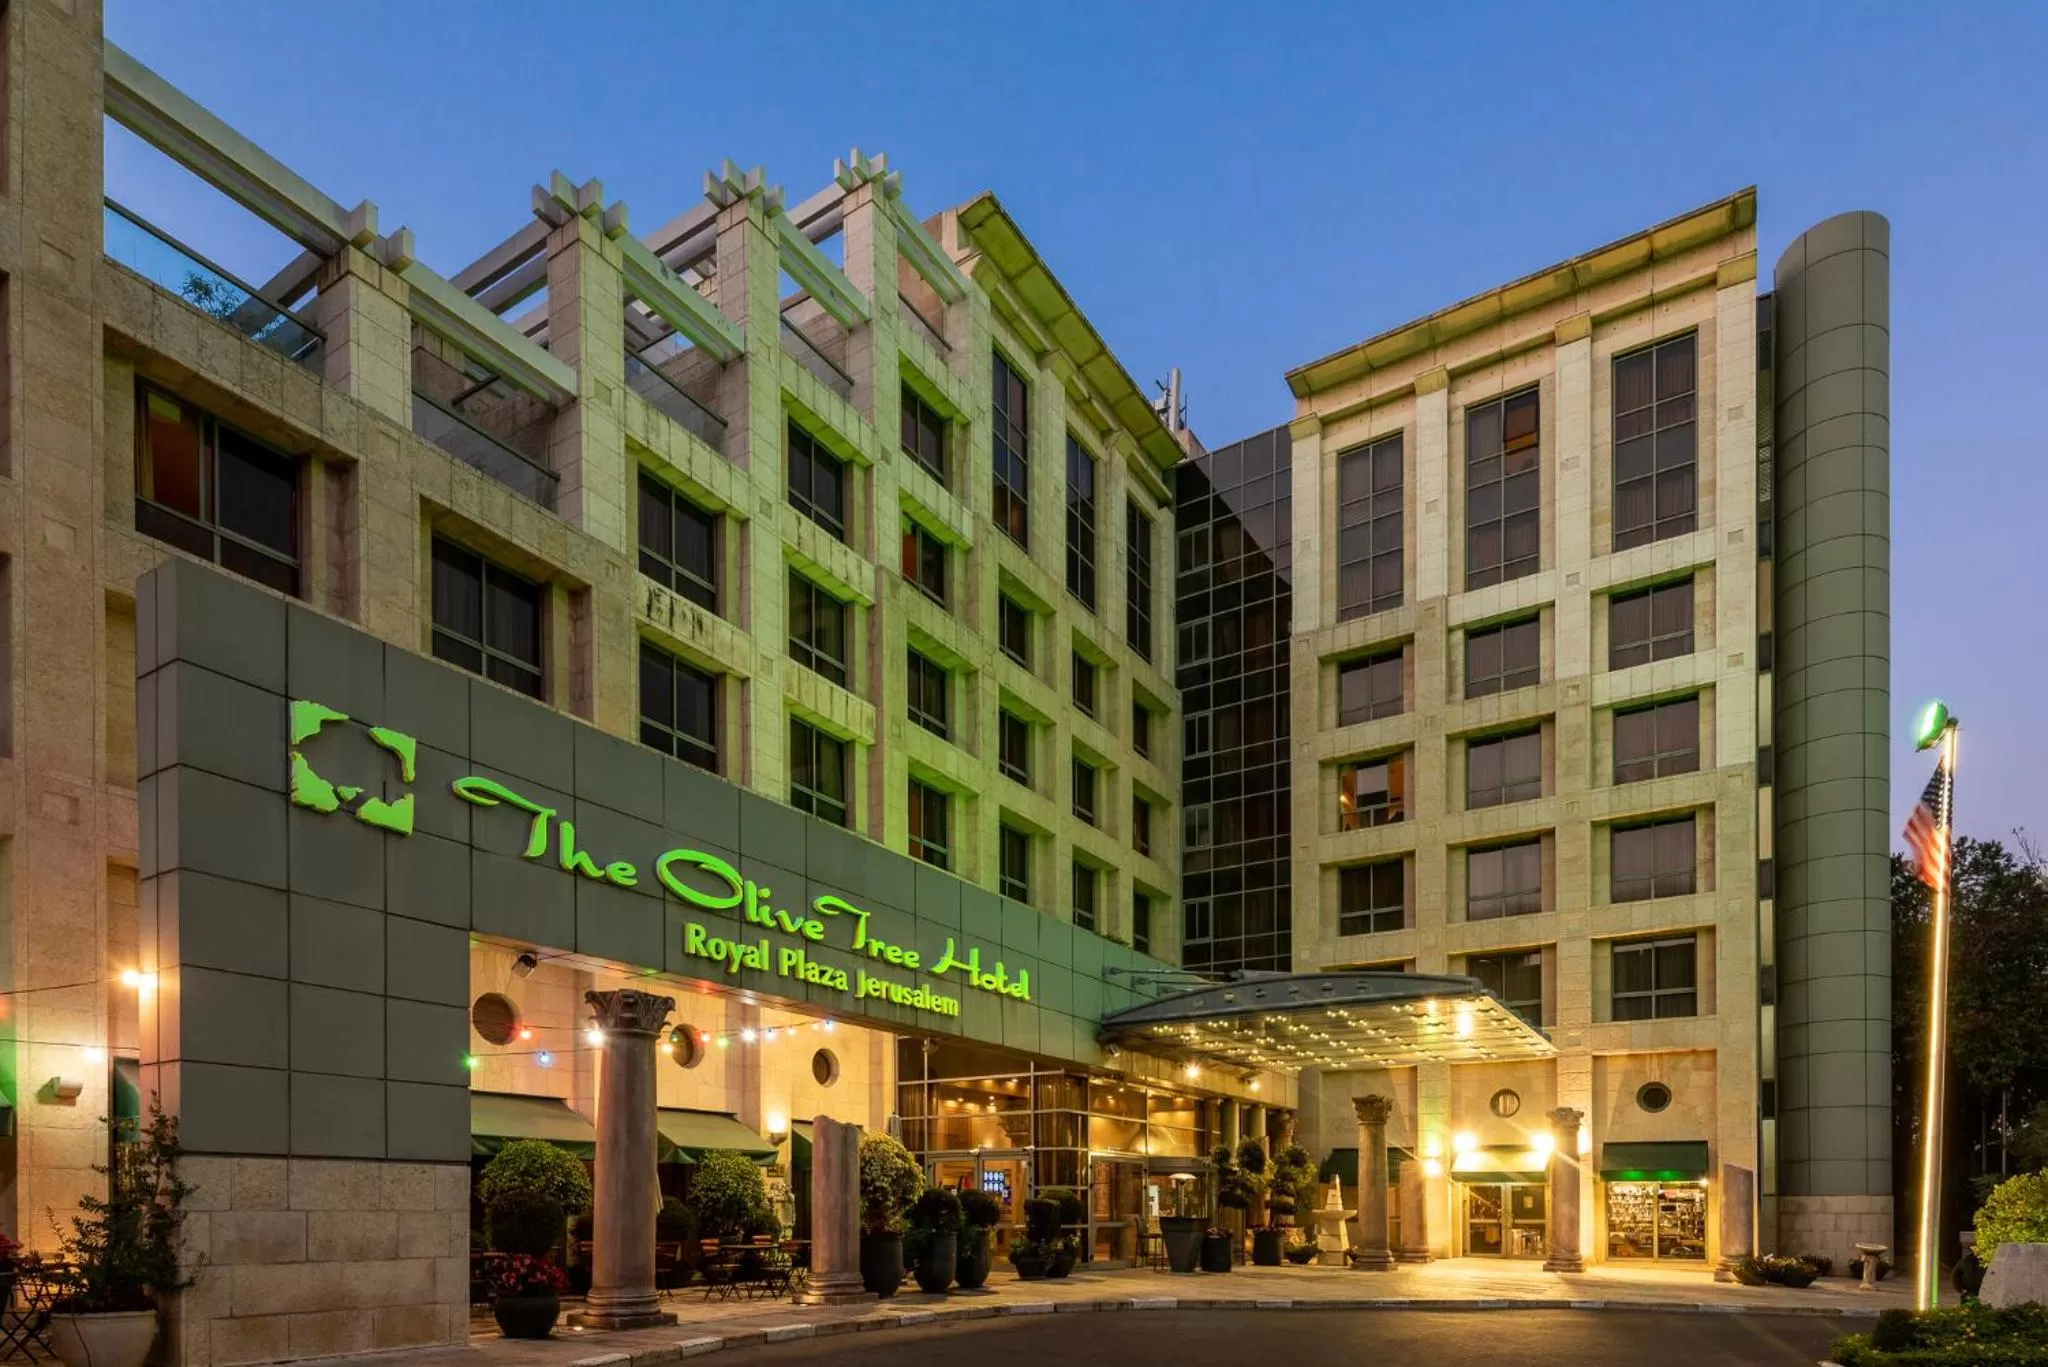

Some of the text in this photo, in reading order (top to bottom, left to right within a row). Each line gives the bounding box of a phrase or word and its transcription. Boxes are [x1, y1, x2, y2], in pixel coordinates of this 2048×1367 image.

[452, 776, 1031, 1001] The Olive Tree Hotel
[684, 922, 959, 1017] Royal Plaza Jerusalem
